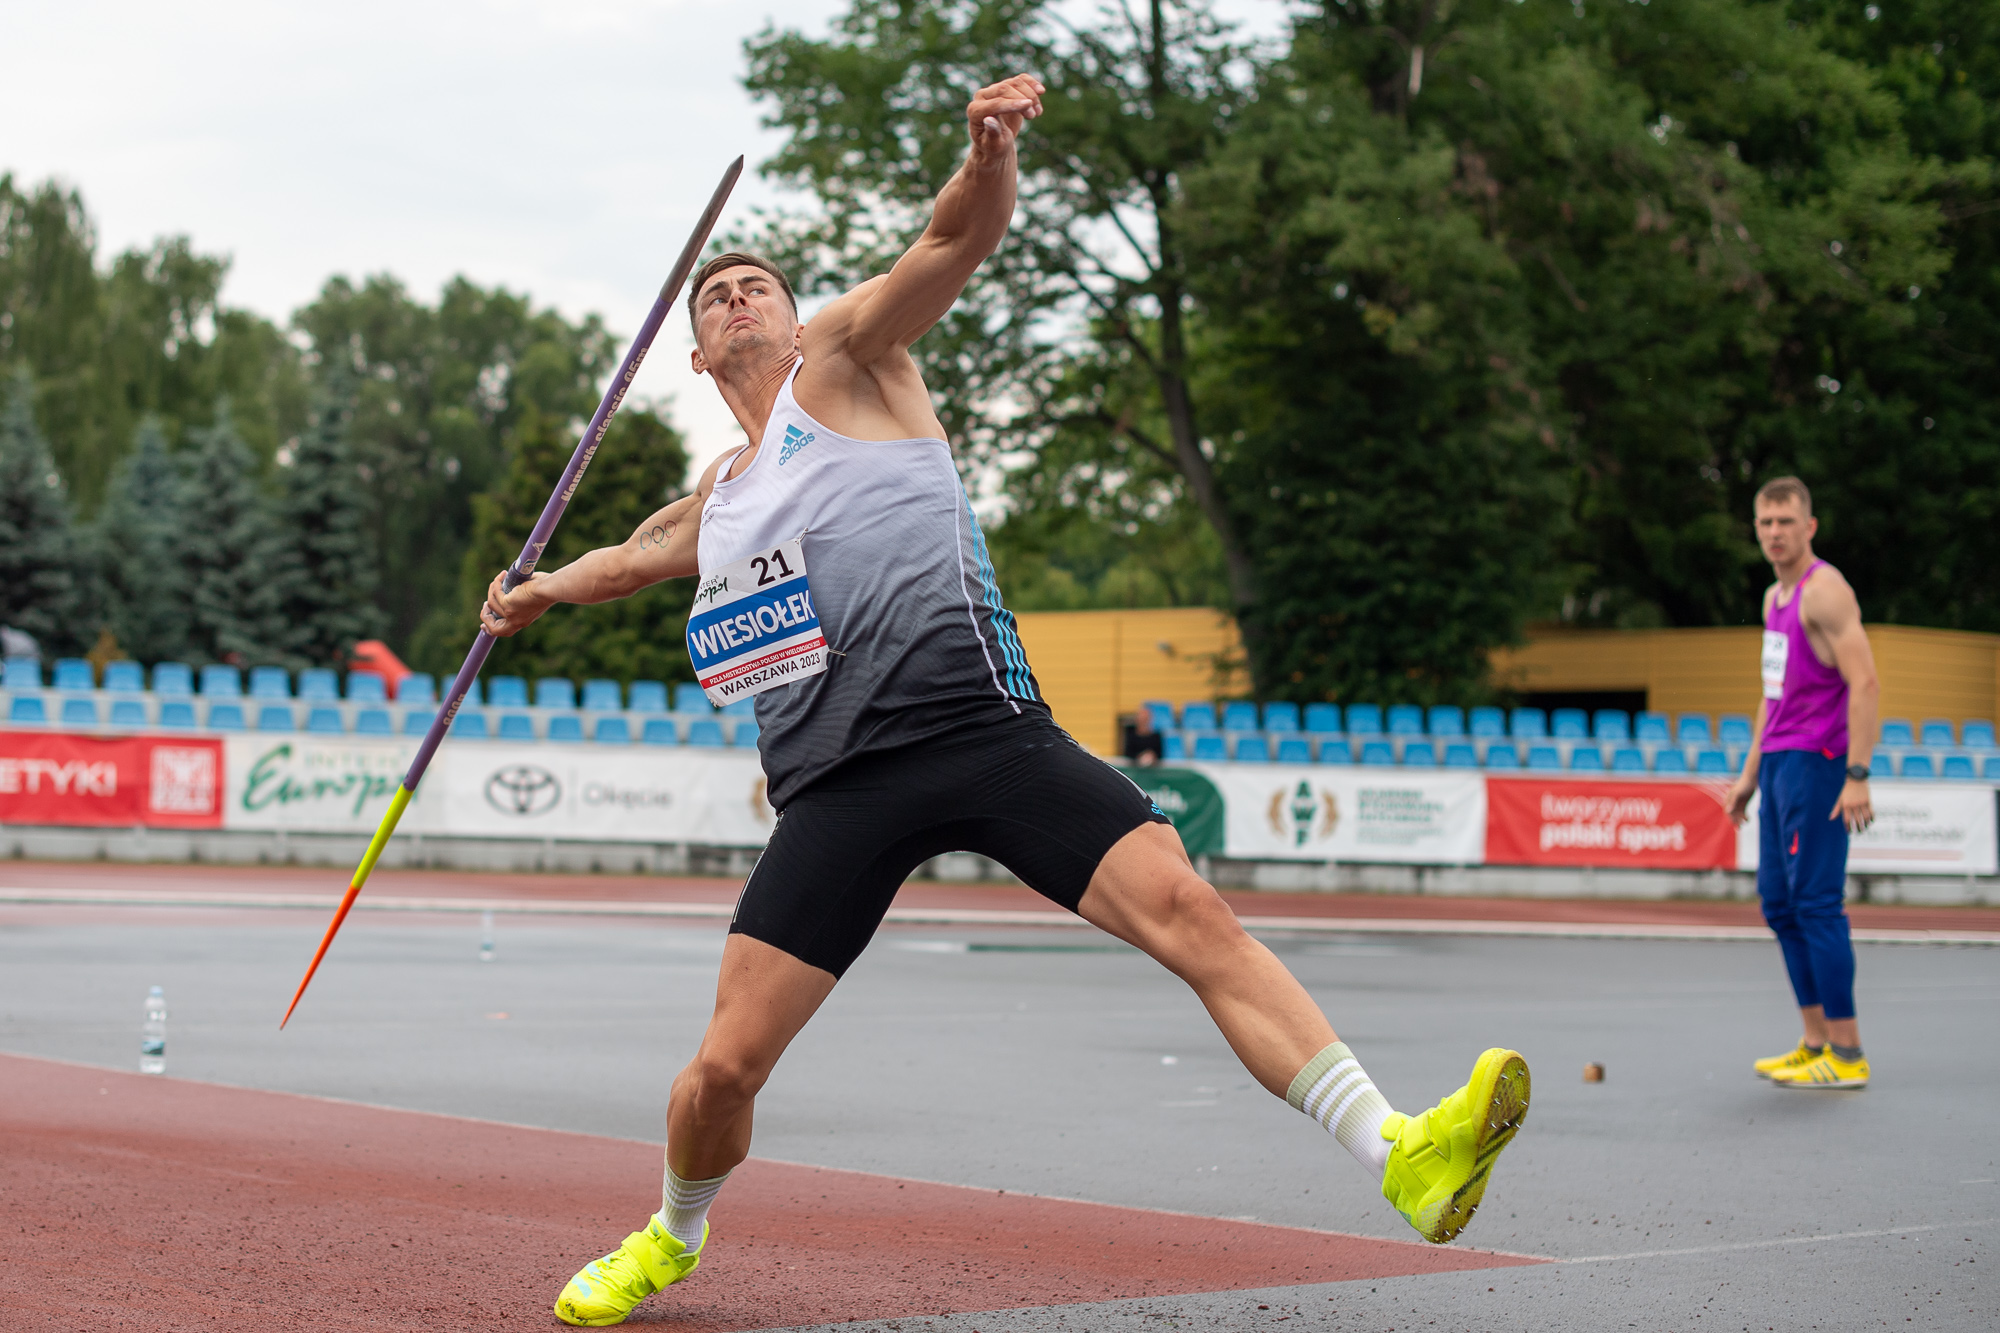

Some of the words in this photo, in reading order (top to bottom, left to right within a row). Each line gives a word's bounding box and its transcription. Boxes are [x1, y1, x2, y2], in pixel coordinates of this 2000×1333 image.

[778, 432, 816, 467] adidas
[750, 549, 795, 587] 21
[690, 589, 816, 659] WIESIOŁEK
[709, 674, 723, 685] PZLA
[722, 661, 762, 682] MISTRZOSTWA
[761, 654, 779, 667] POLSKI
[779, 652, 785, 661] W
[720, 660, 799, 696] WARSZAWA
[799, 652, 821, 669] 2023
[1541, 792, 1662, 824] tworzymy
[1540, 821, 1616, 852] polski
[1618, 821, 1687, 855] sport
